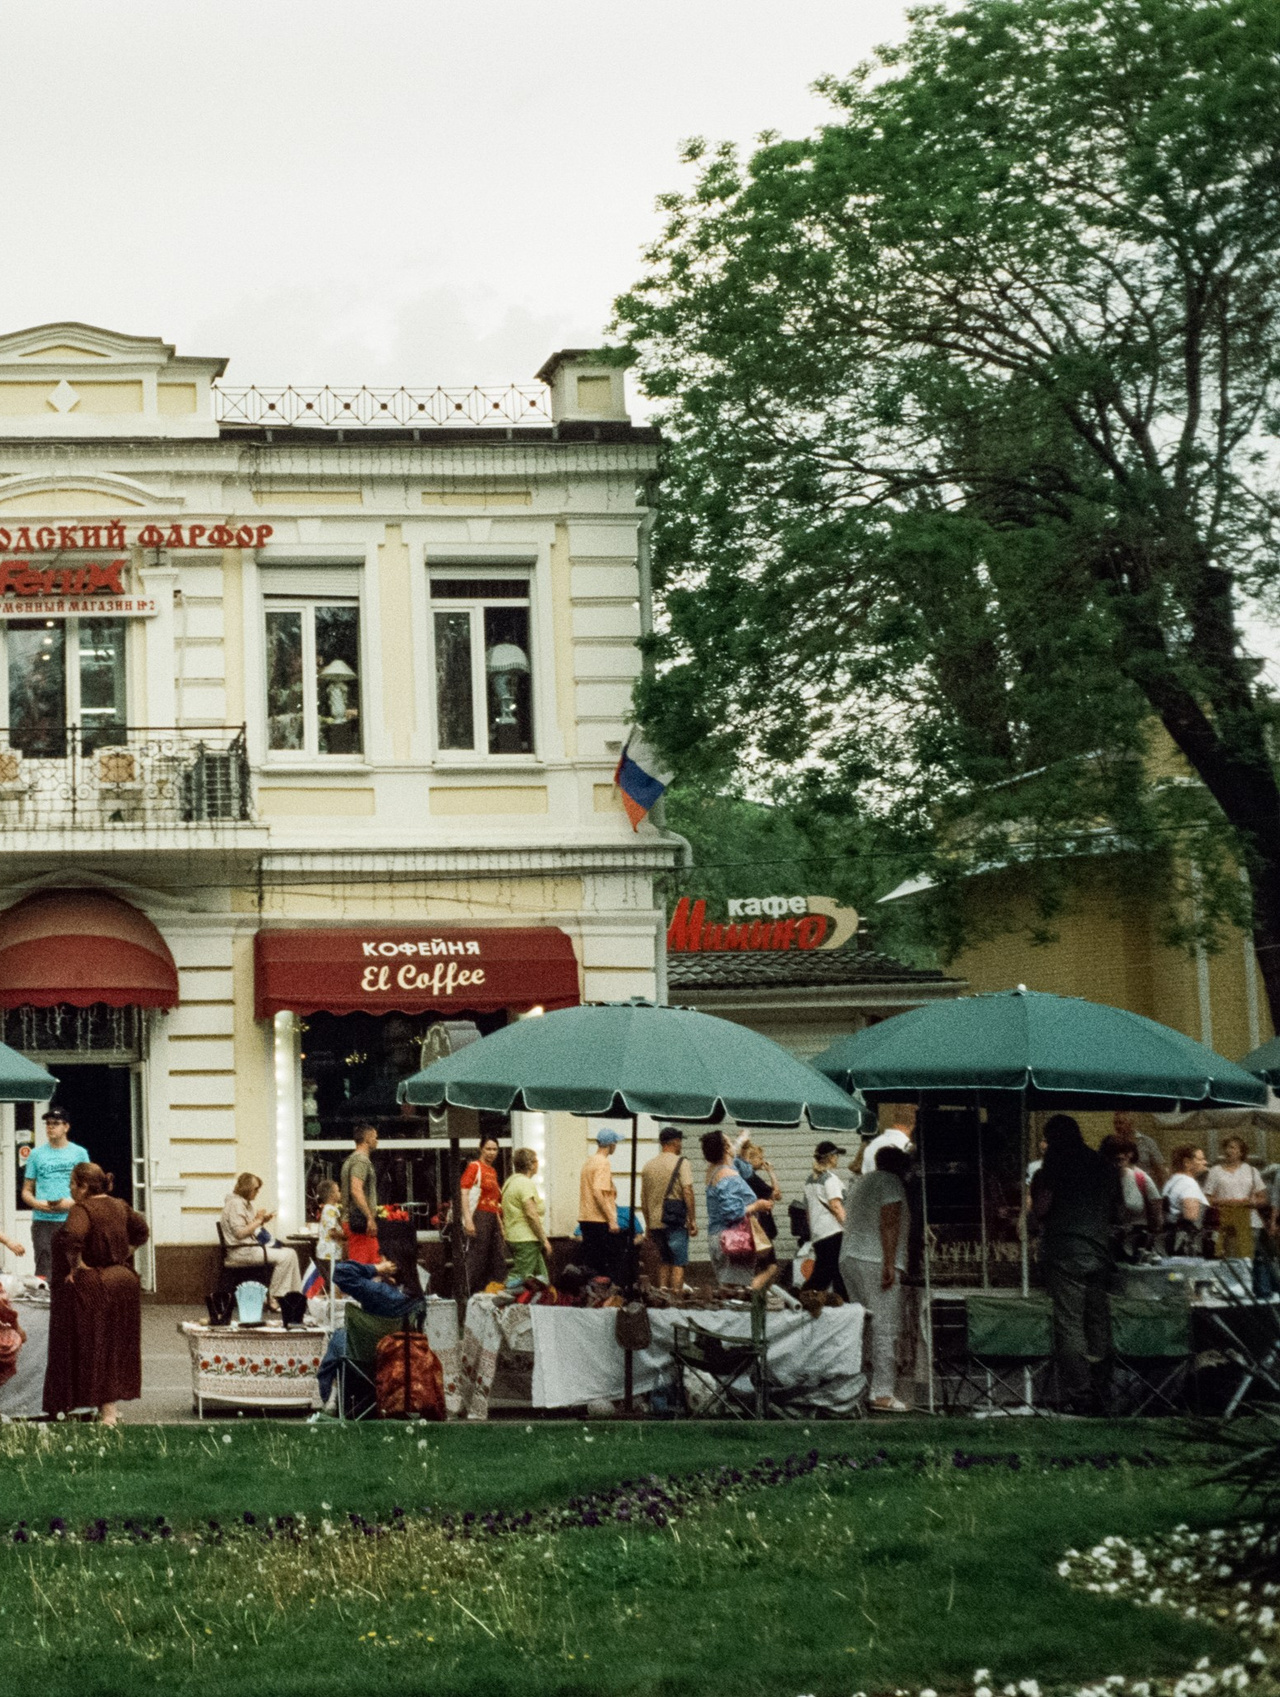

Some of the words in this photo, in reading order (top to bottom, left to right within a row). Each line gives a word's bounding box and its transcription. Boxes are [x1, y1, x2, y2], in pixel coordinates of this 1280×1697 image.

[137, 523, 273, 550] ФАРФОР
[68, 600, 133, 613] МАГАЗИН
[727, 895, 807, 918] кафе
[666, 896, 827, 952] Мимино
[361, 937, 481, 957] КОФЕЙНЯ
[360, 964, 392, 992] El
[396, 961, 486, 996] Coffee
